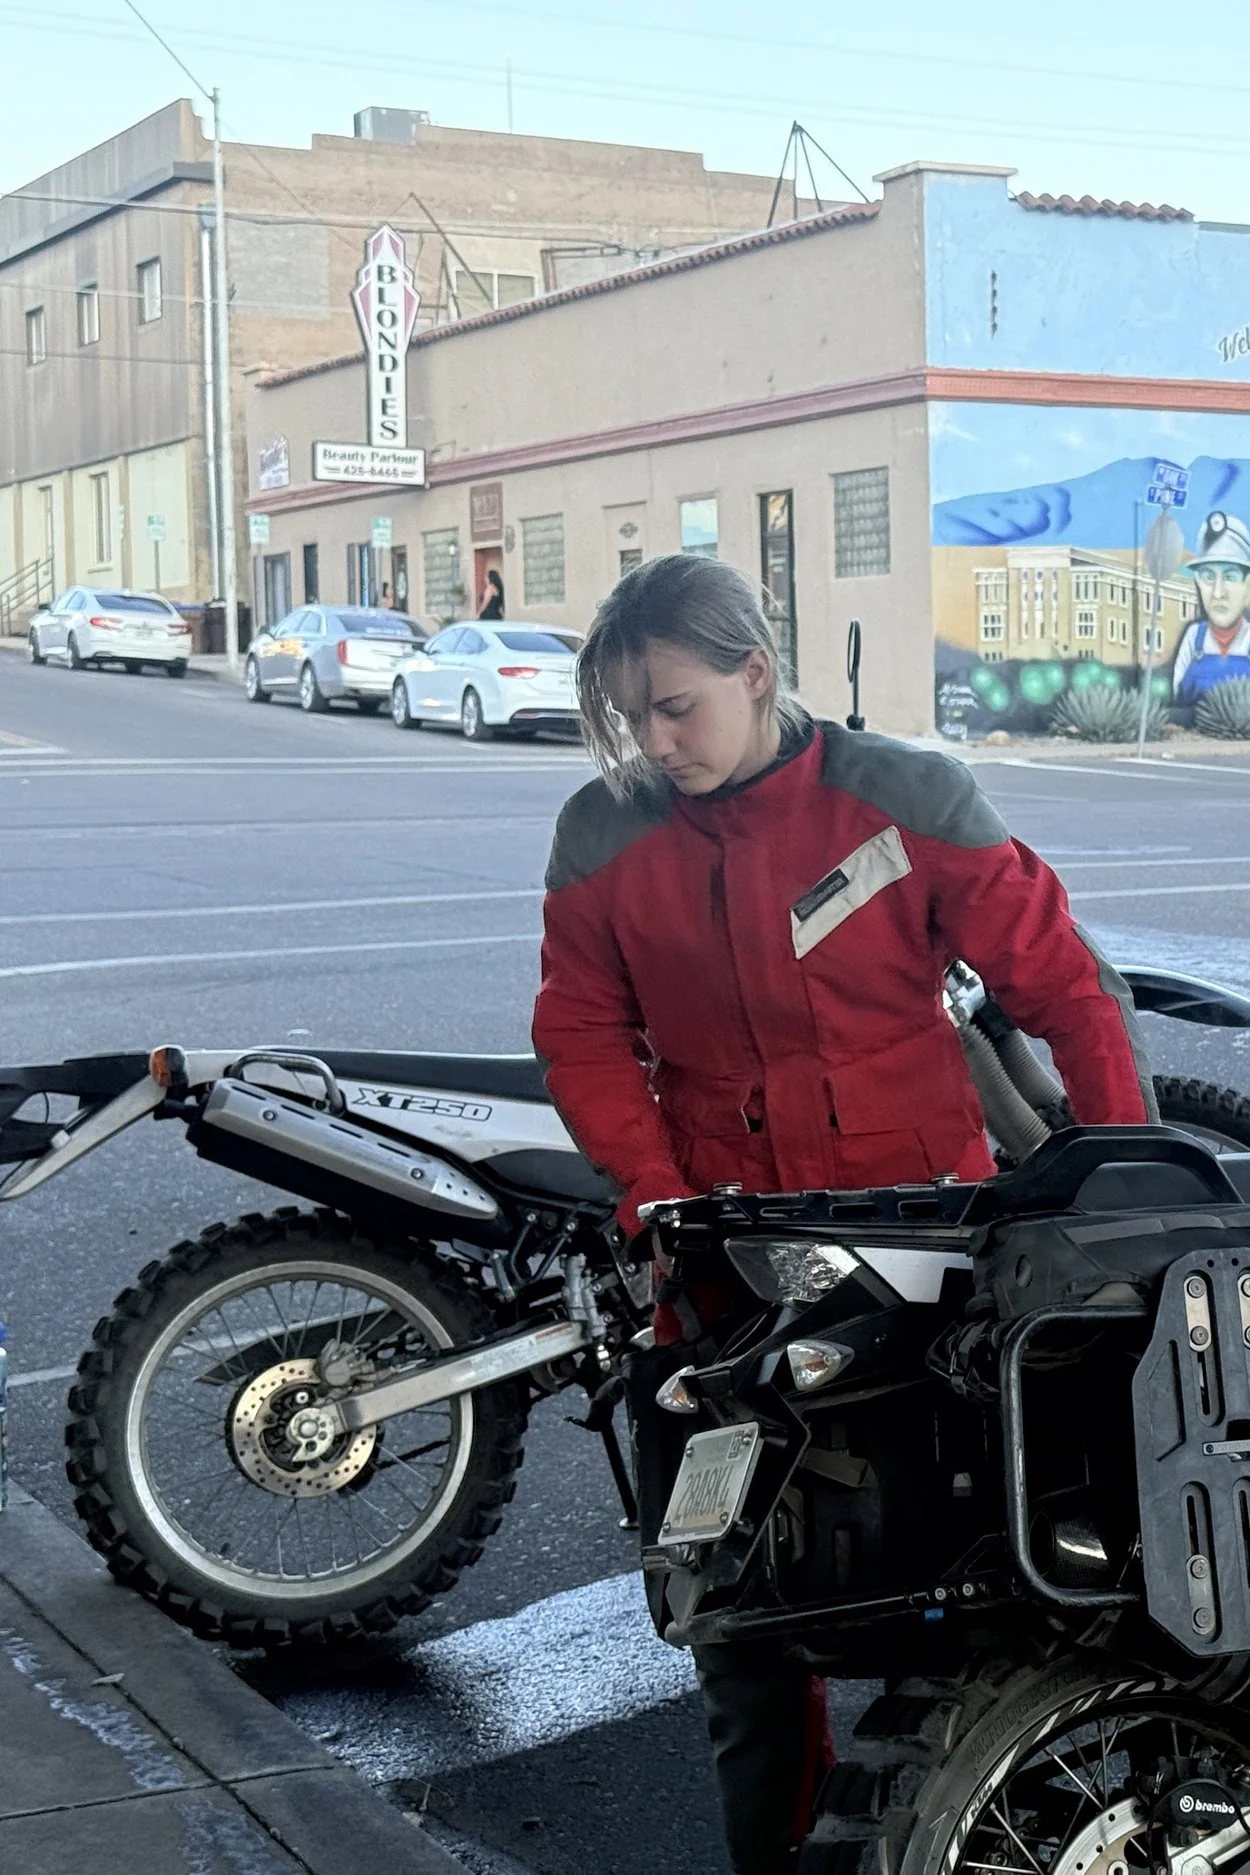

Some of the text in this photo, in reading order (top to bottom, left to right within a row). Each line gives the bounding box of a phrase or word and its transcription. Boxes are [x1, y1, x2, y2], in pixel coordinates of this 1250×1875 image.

[376, 264, 398, 440] BLONDIES
[323, 449, 366, 462] Beauty
[353, 1087, 493, 1122] XT250
[1195, 1798, 1235, 1814] brembo
